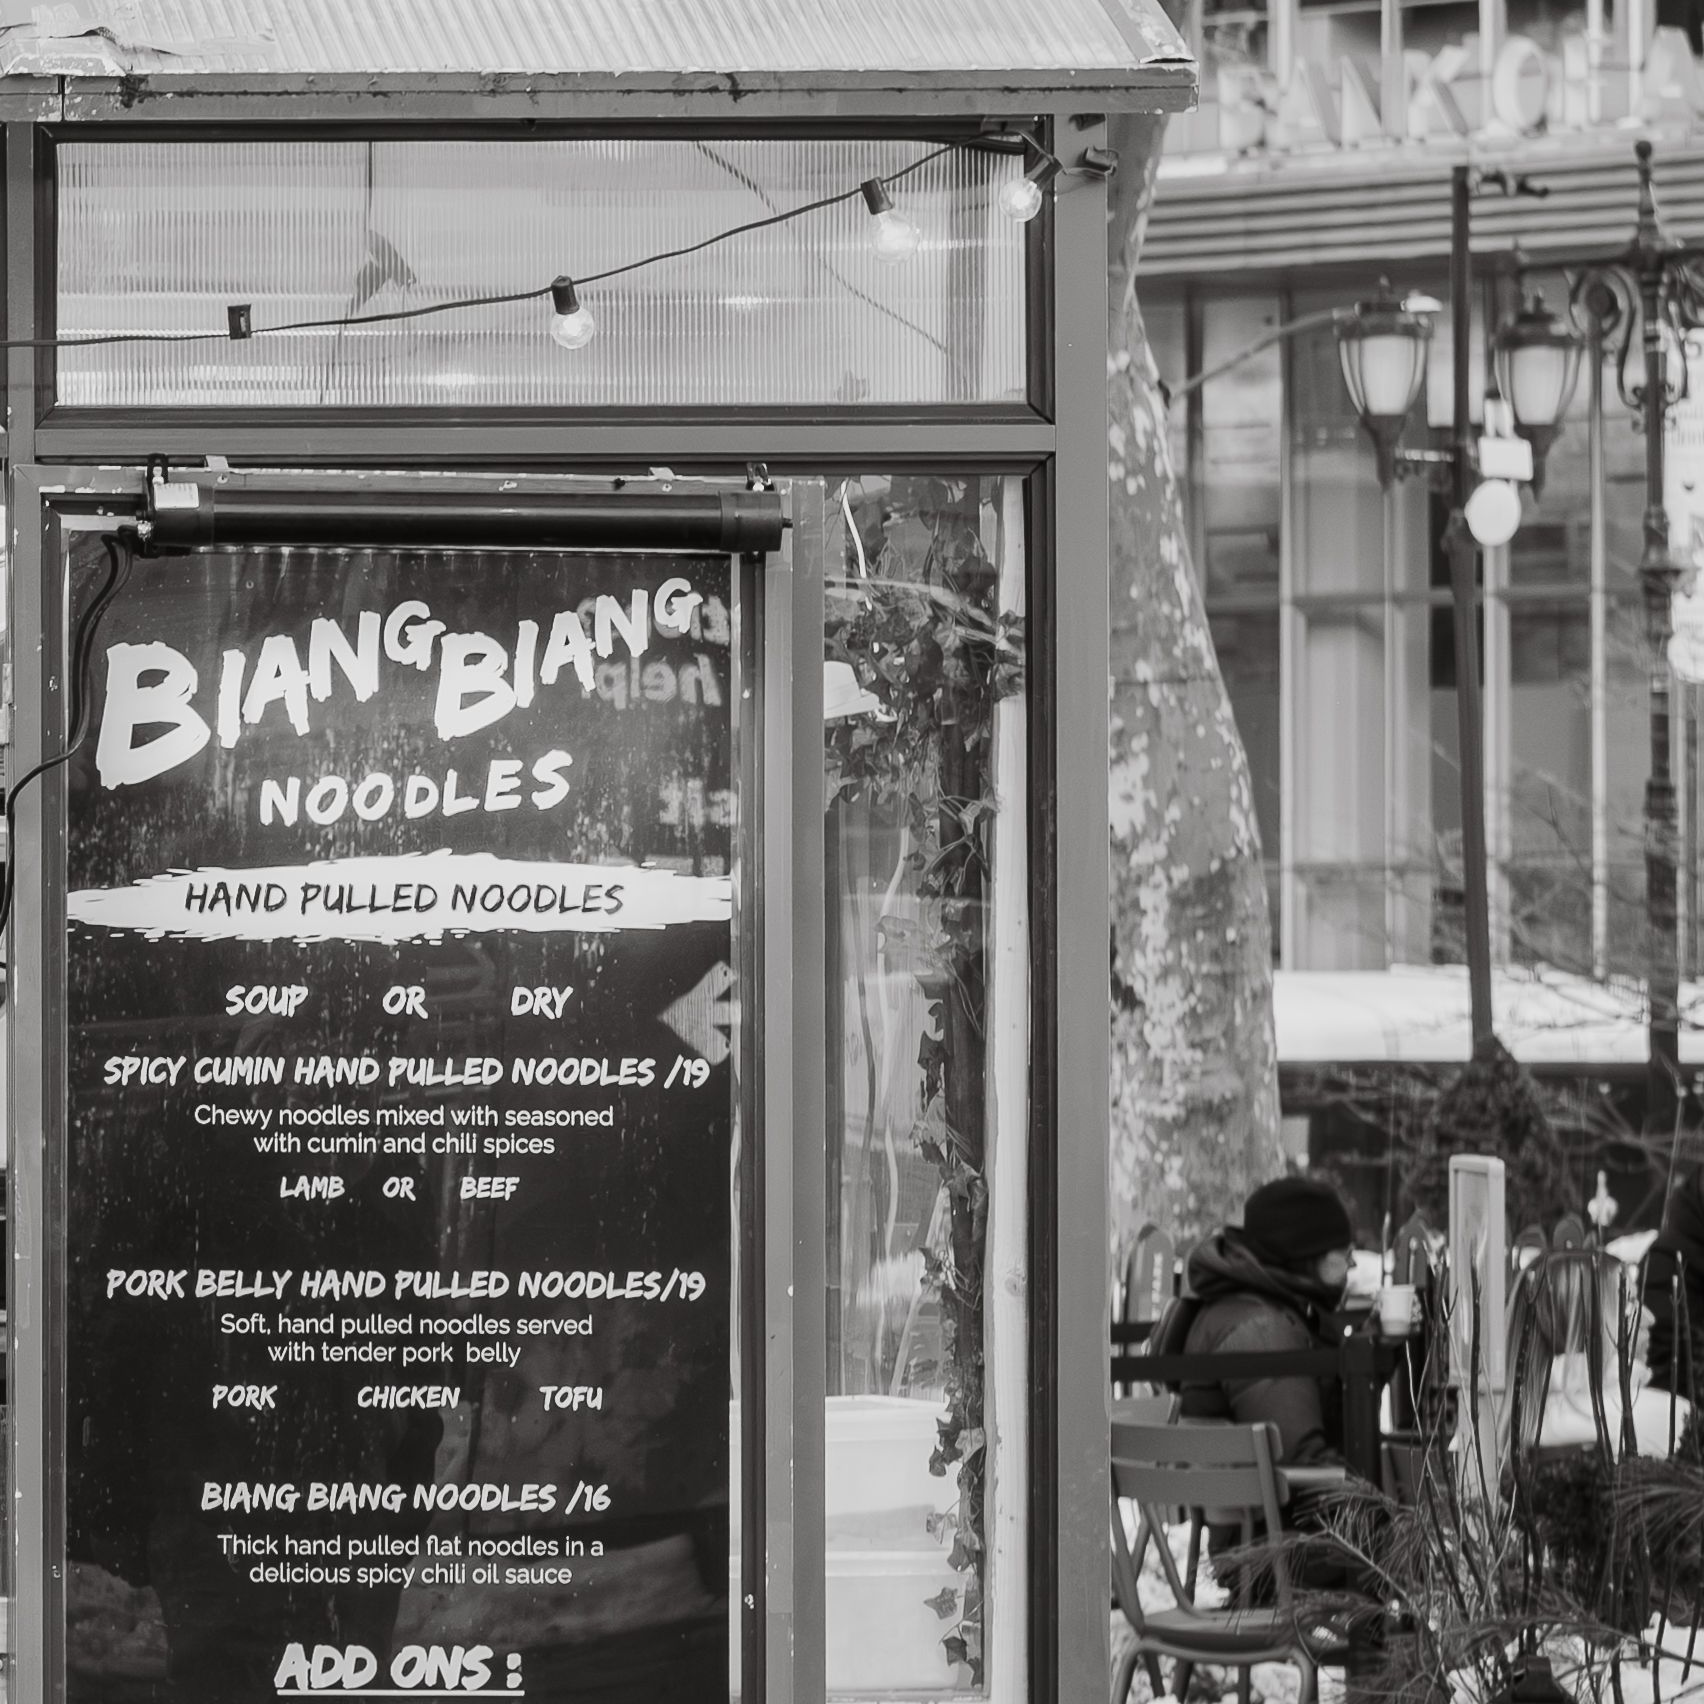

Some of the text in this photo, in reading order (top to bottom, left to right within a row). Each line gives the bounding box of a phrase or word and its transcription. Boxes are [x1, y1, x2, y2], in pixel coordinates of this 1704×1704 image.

[259, 746, 573, 828] NOODLES
[185, 882, 625, 917] HAND PULLED NOODLES
[225, 984, 574, 1020] SOUP OR DRY
[103, 1054, 711, 1089] SPICY CUMIN HAND PULLED NOODLES /19
[194, 1103, 614, 1131] Chewy noodles mixed with seasoned
[279, 1175, 521, 1202] LAMB OR BEEF
[220, 1312, 593, 1339] Soft, hand pulled noodles served
[200, 1480, 612, 1515] BIANG BIANG NOODLES /16
[274, 1643, 377, 1690] ADD
